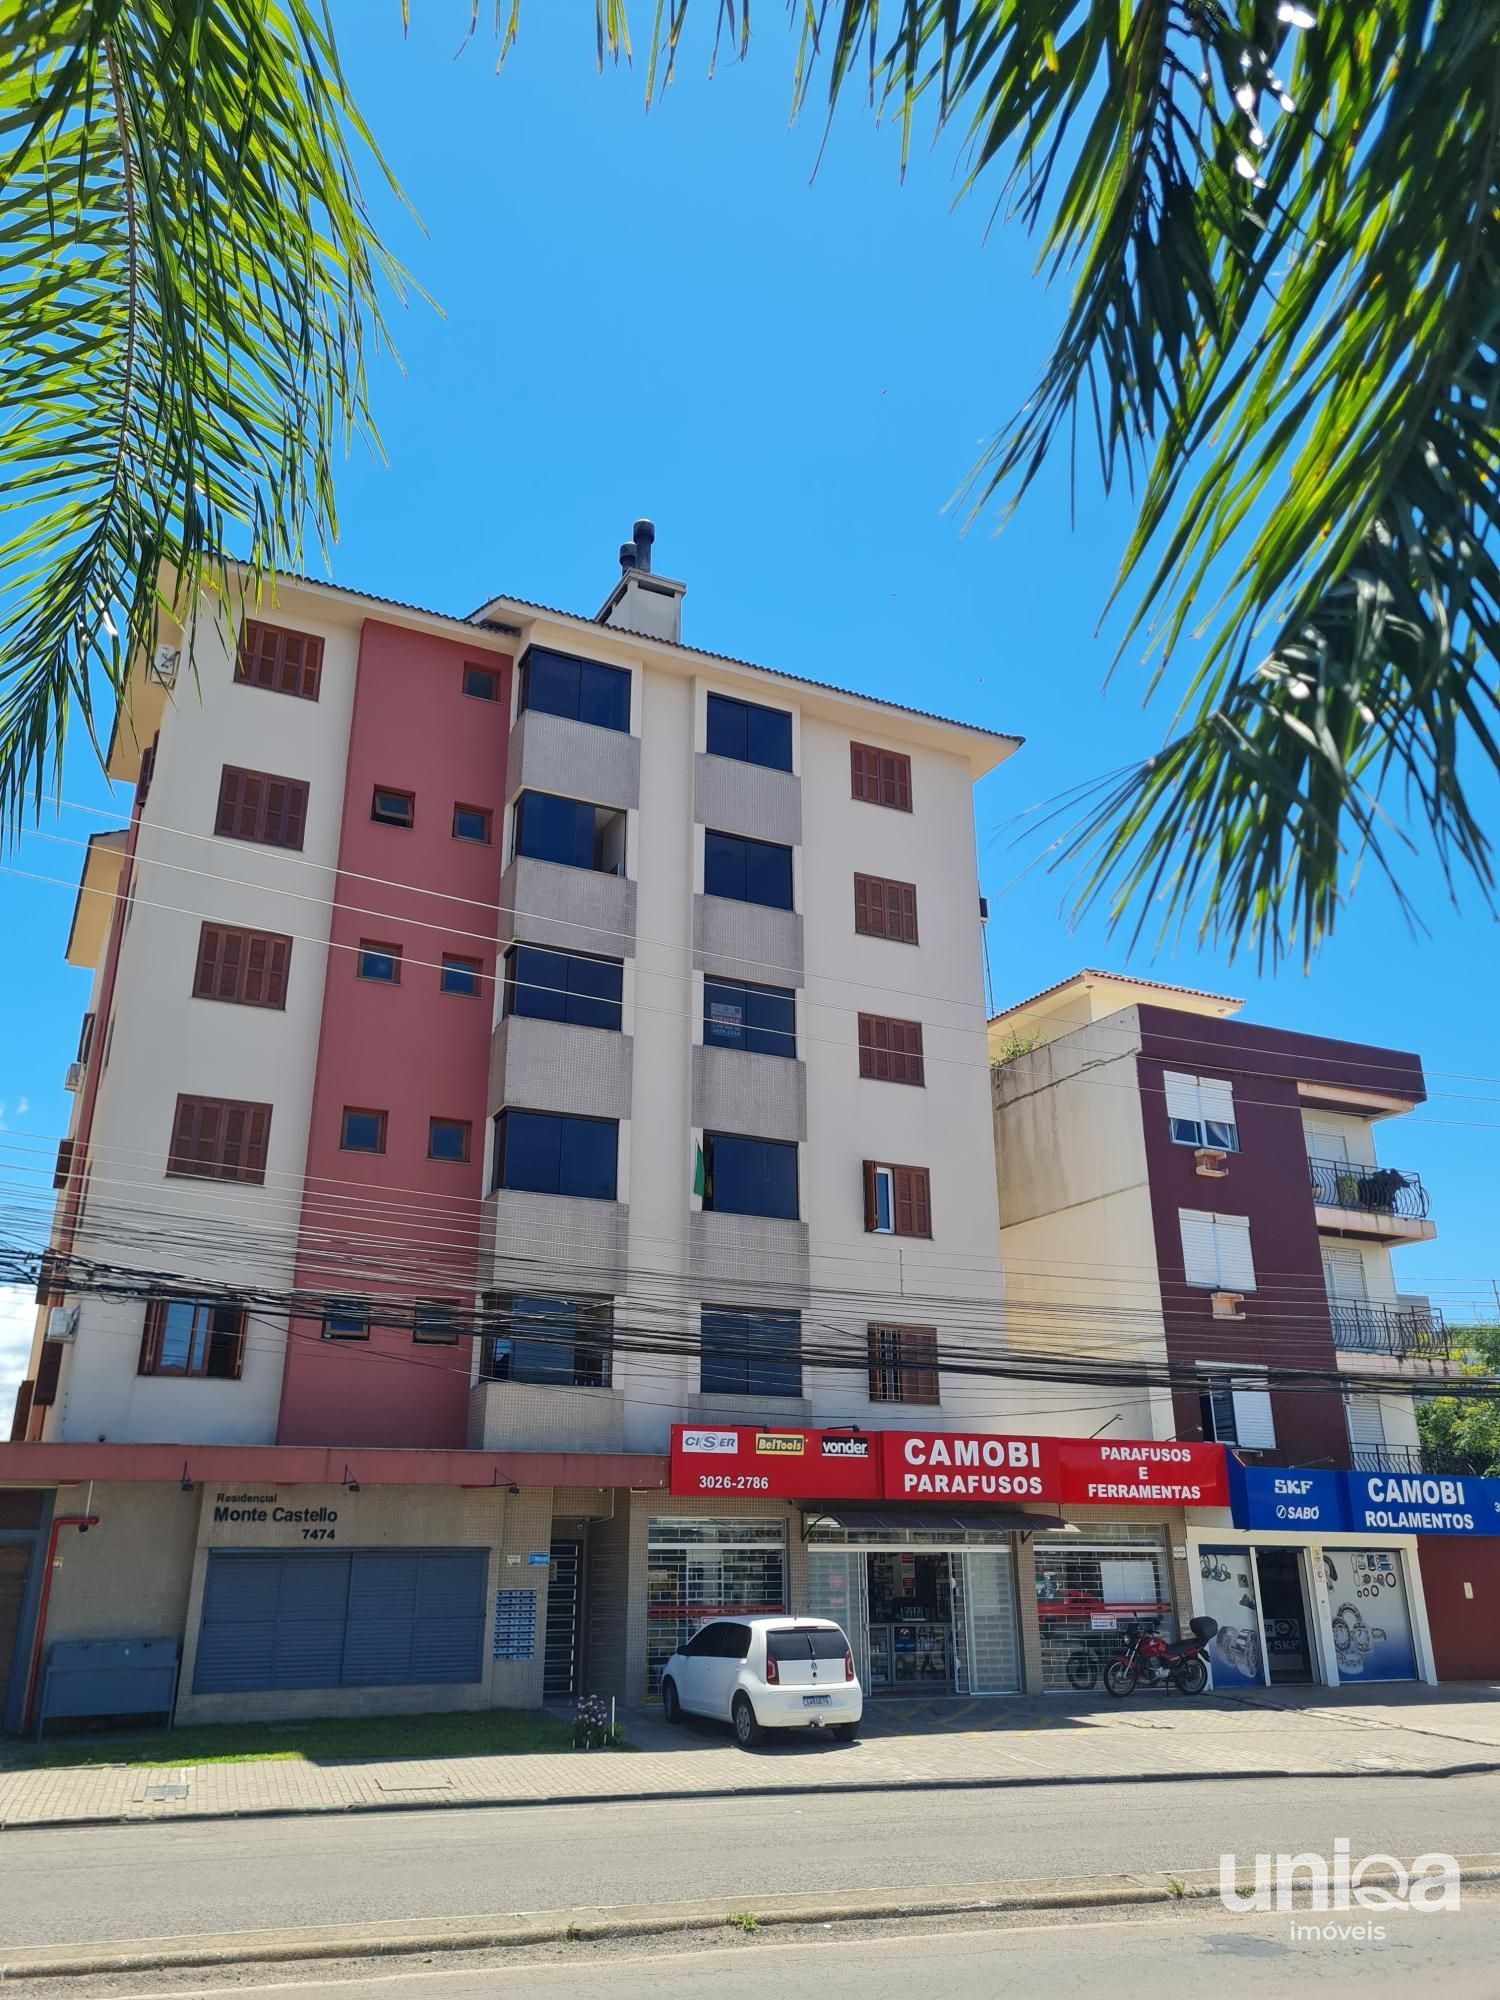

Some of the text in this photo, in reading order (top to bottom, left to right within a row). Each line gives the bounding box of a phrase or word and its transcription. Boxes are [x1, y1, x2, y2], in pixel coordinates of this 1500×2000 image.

[685, 1433, 736, 1450] CISER
[758, 1438, 802, 1451] BelTools
[904, 1438, 1041, 1468] CAMOBI
[1100, 1446, 1191, 1462] PARAFUSOS
[1138, 1466, 1149, 1480] E
[699, 1475, 769, 1490] 3026-2786
[904, 1473, 1043, 1495] PARAFUSOS
[1274, 1479, 1313, 1495] SKF
[216, 1493, 278, 1504] Residencial
[1088, 1483, 1201, 1499] FERRAMENTAS
[1367, 1477, 1465, 1505] CAMOBI
[213, 1507, 338, 1522] Monte Castello
[1364, 1510, 1475, 1530] ROLAMENTOS
[302, 1529, 336, 1540] 7474
